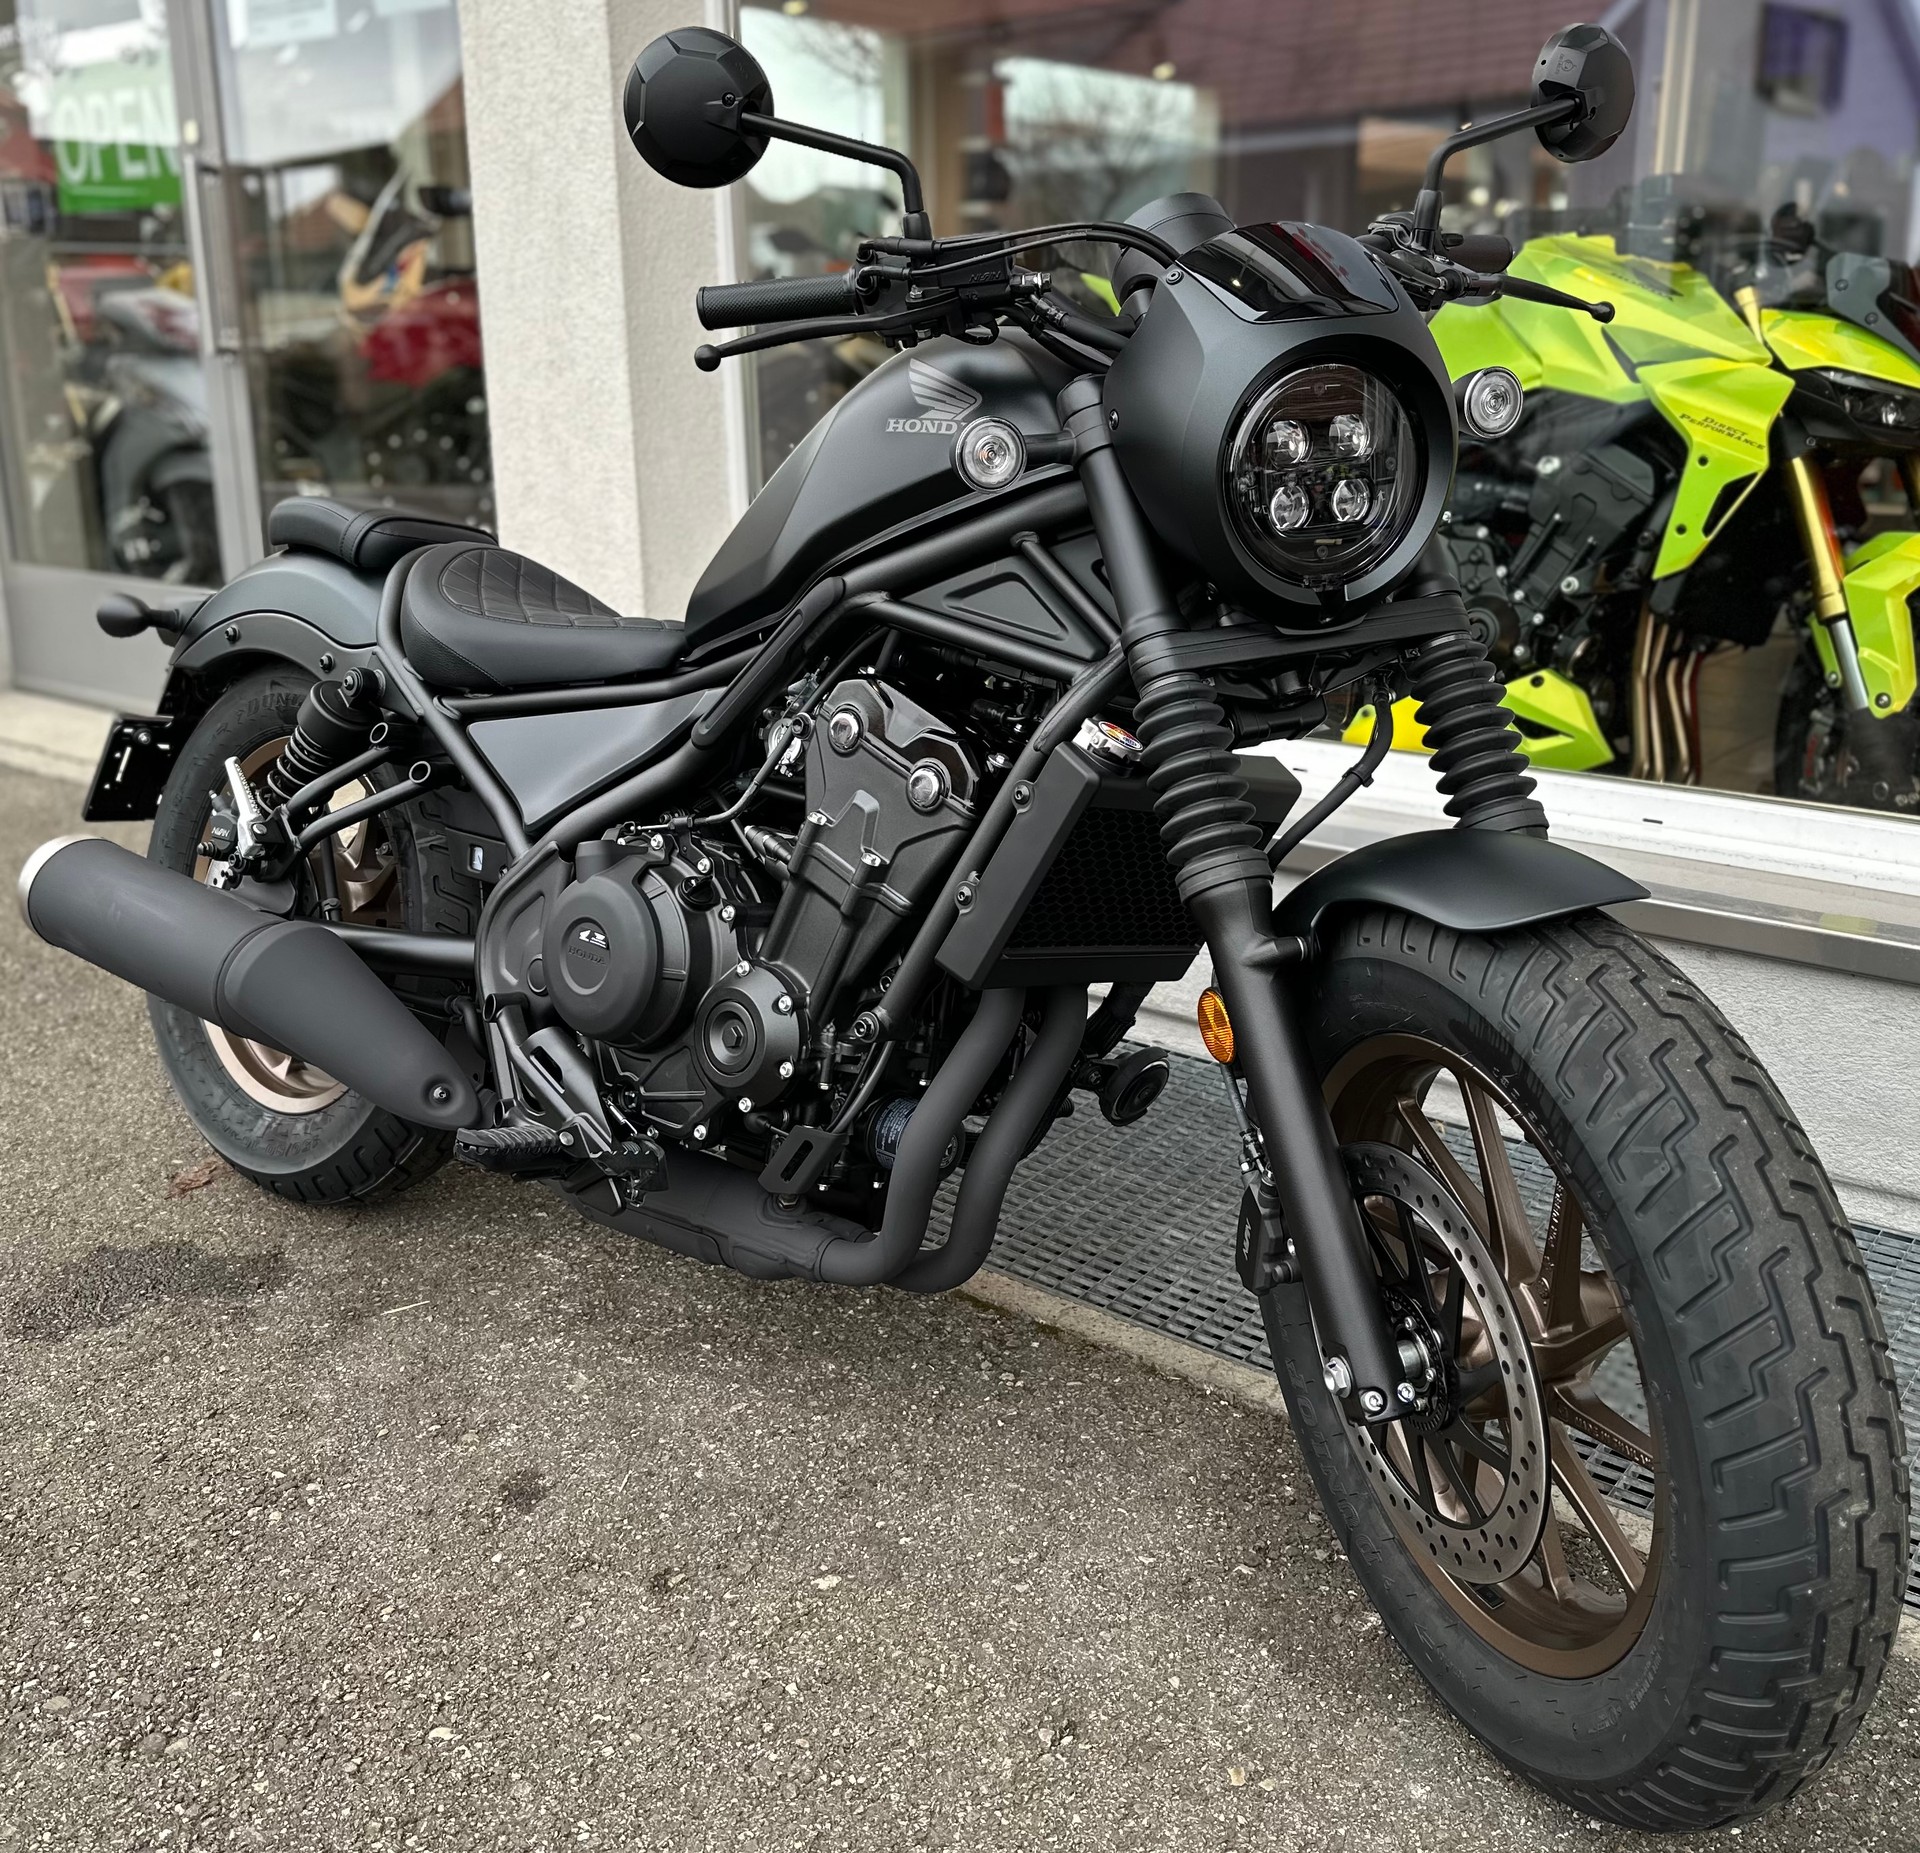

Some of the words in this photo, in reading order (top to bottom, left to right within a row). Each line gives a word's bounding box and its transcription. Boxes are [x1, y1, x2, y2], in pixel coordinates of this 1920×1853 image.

[54, 87, 181, 184] OPEN
[885, 418, 967, 435] HOND
[246, 692, 307, 717] DUNL
